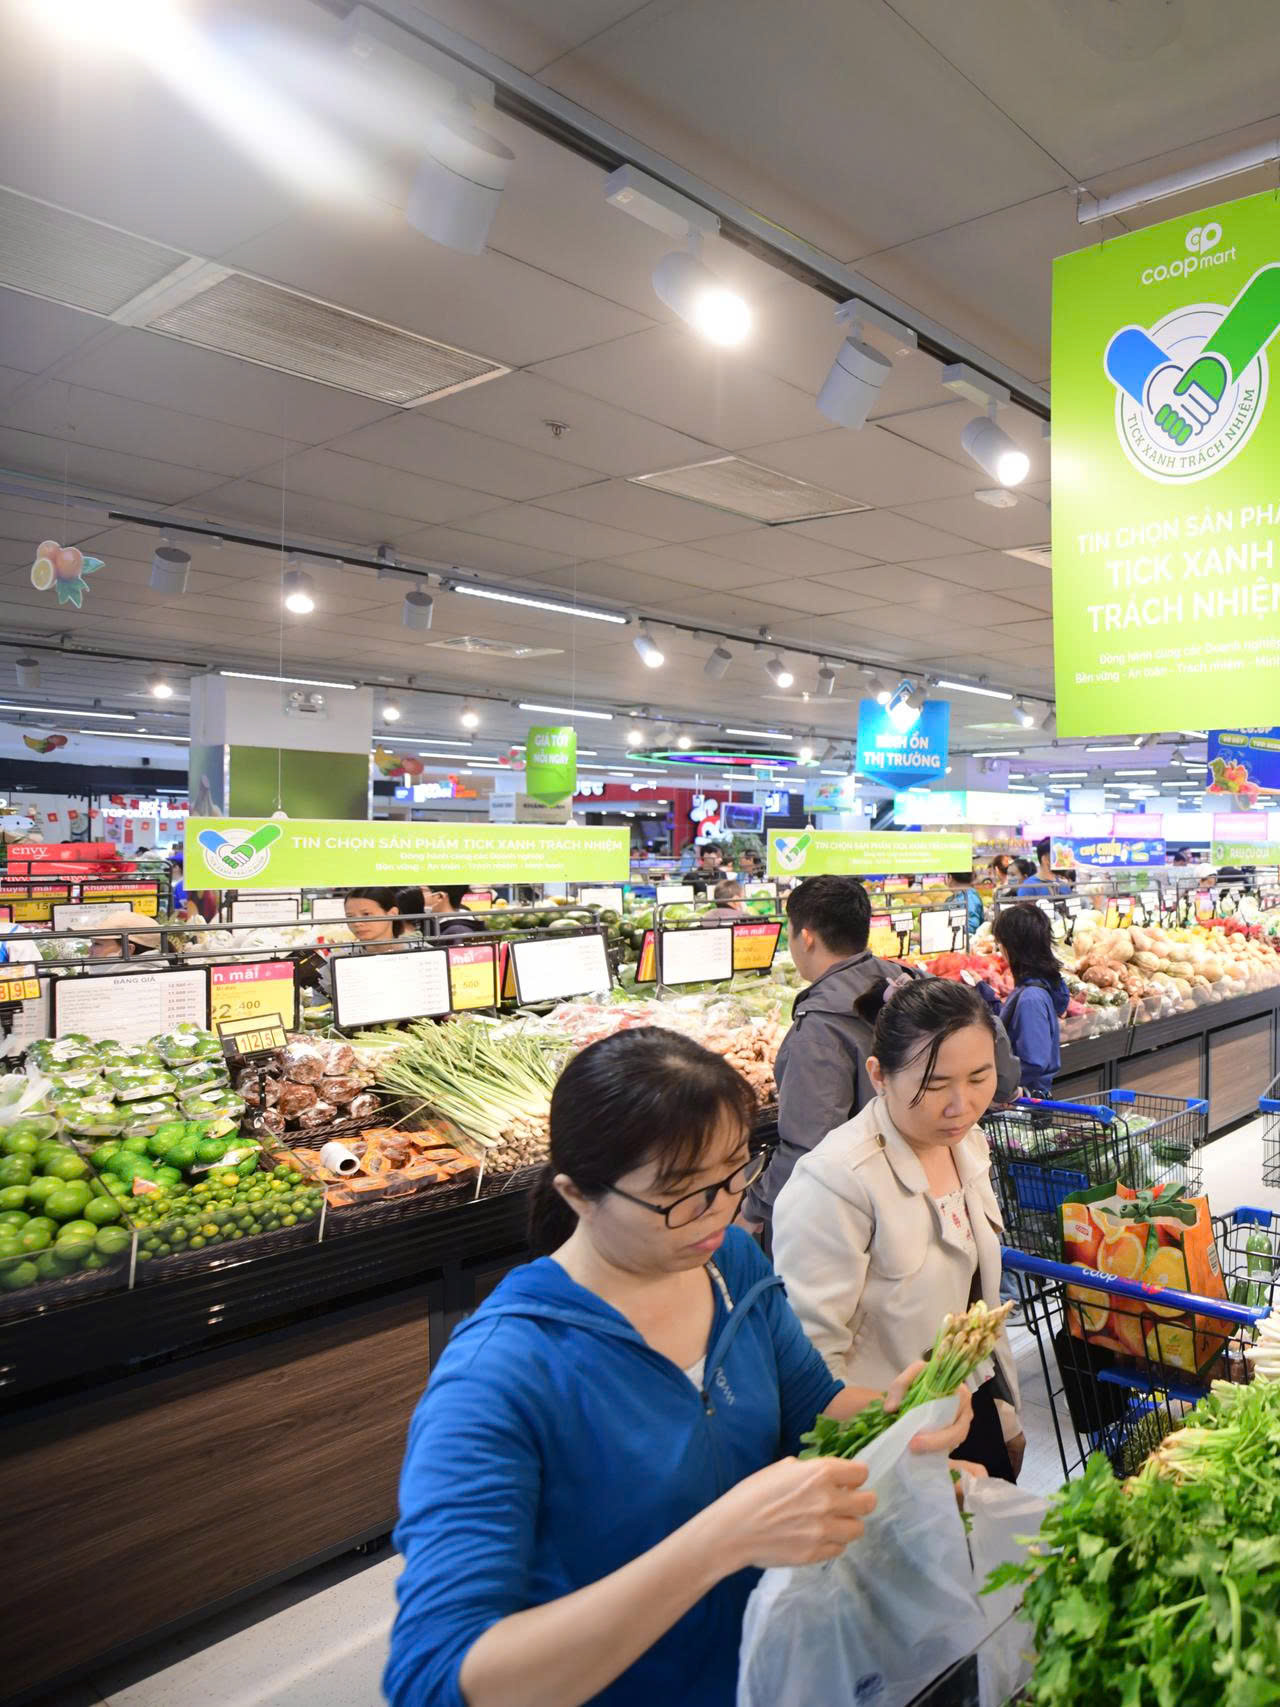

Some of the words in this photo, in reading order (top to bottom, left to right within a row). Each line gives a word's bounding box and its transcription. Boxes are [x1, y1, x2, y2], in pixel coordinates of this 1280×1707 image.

[1128, 413, 1145, 447] TICK
[1142, 443, 1176, 468] XANH
[1179, 440, 1226, 468] TRÁCH
[1225, 389, 1255, 441] NHIỆM
[1077, 532, 1109, 555] TIN
[1115, 518, 1179, 550] CHỌN
[1185, 505, 1233, 537] SẢN
[1107, 553, 1172, 591] TICK
[1183, 539, 1273, 580] XANH
[1087, 592, 1183, 632] TRÁCH
[12, 847, 48, 859] envy
[292, 837, 320, 848] TIN
[325, 837, 376, 852] CHỌN
[415, 834, 460, 849] PHẨM
[463, 839, 494, 849] TICK
[496, 839, 536, 849] XANH
[539, 837, 582, 849] TRÁCH
[584, 838, 623, 852] NHIỆM
